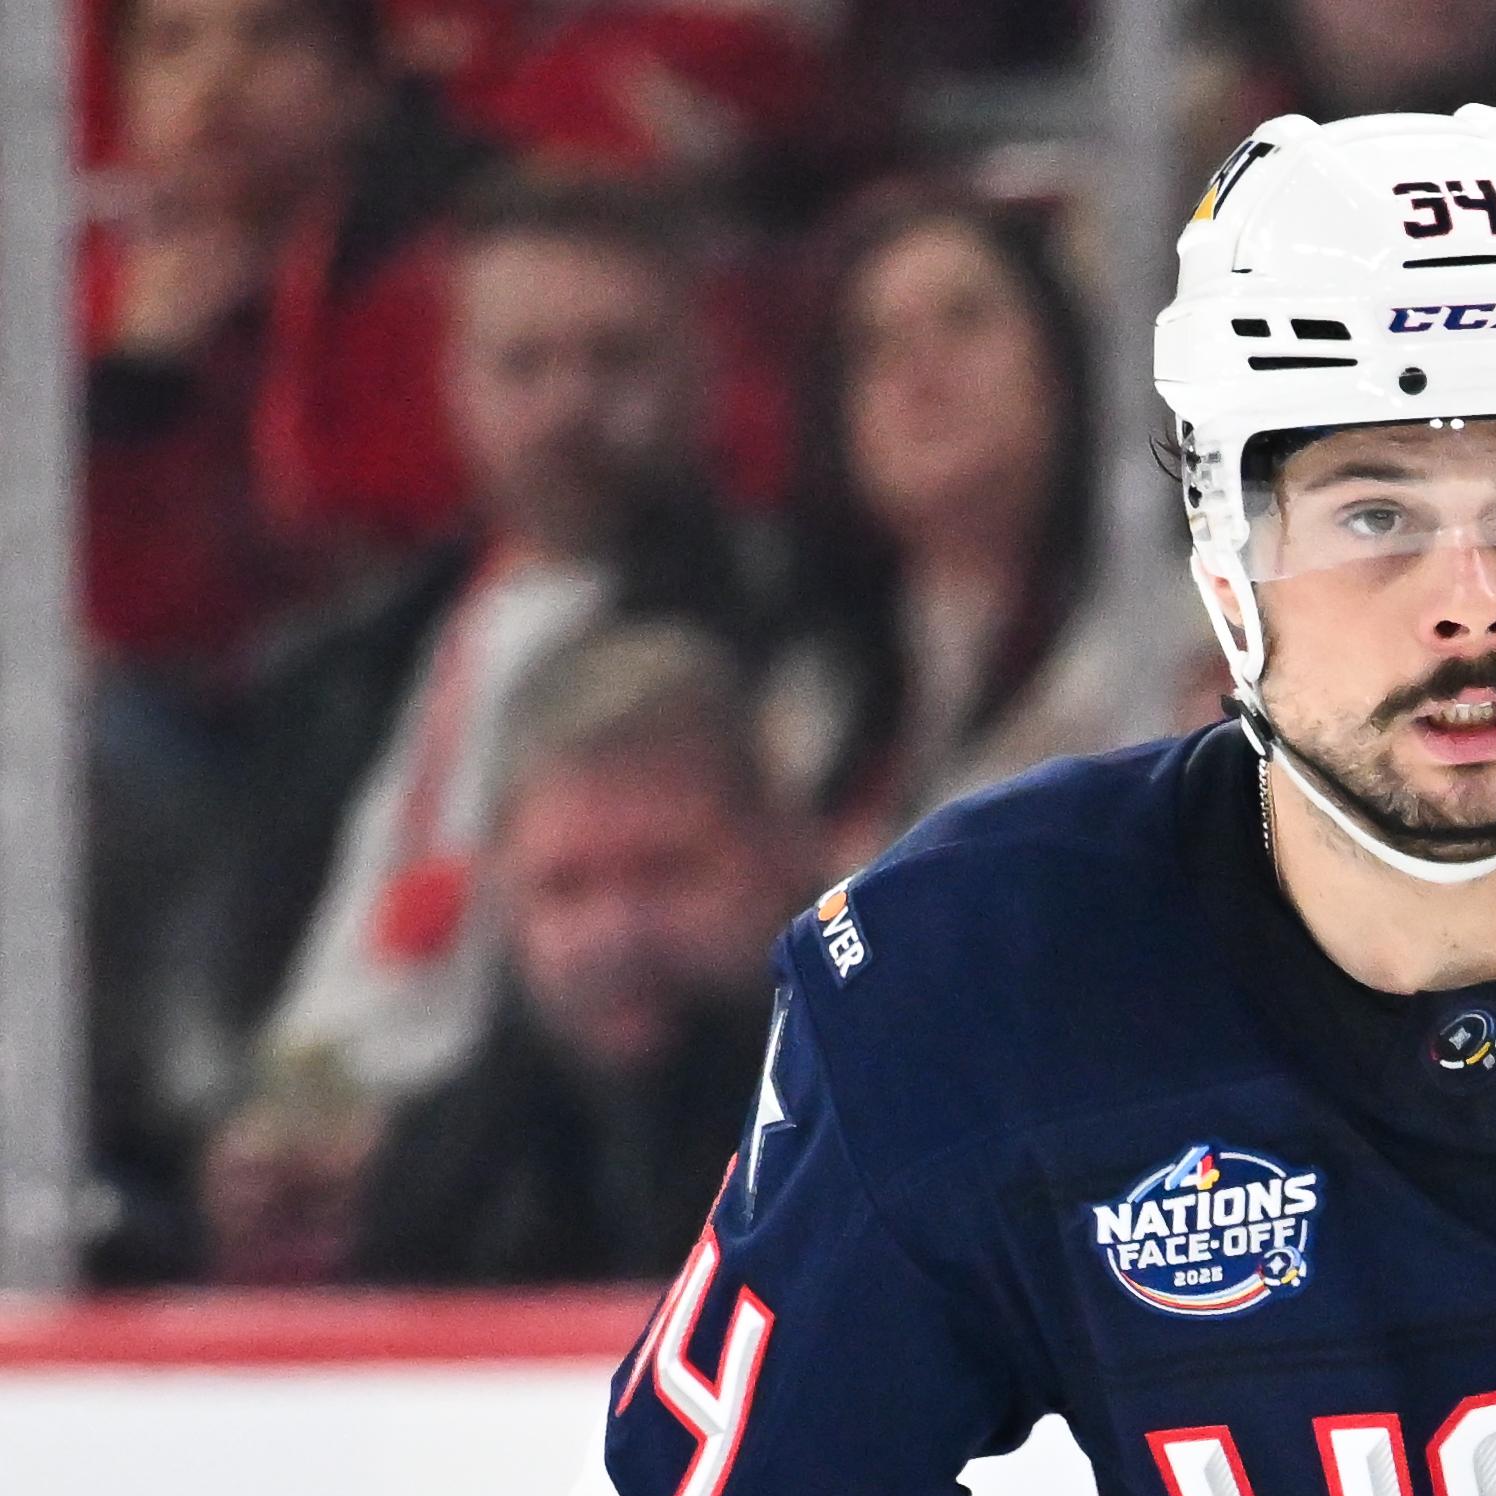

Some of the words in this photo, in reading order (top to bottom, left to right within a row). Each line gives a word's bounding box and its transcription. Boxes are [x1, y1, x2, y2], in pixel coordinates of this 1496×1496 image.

[817, 876, 865, 979] OVER
[1093, 1172, 1317, 1244] NATIONS
[1173, 1266, 1223, 1287] 2025
